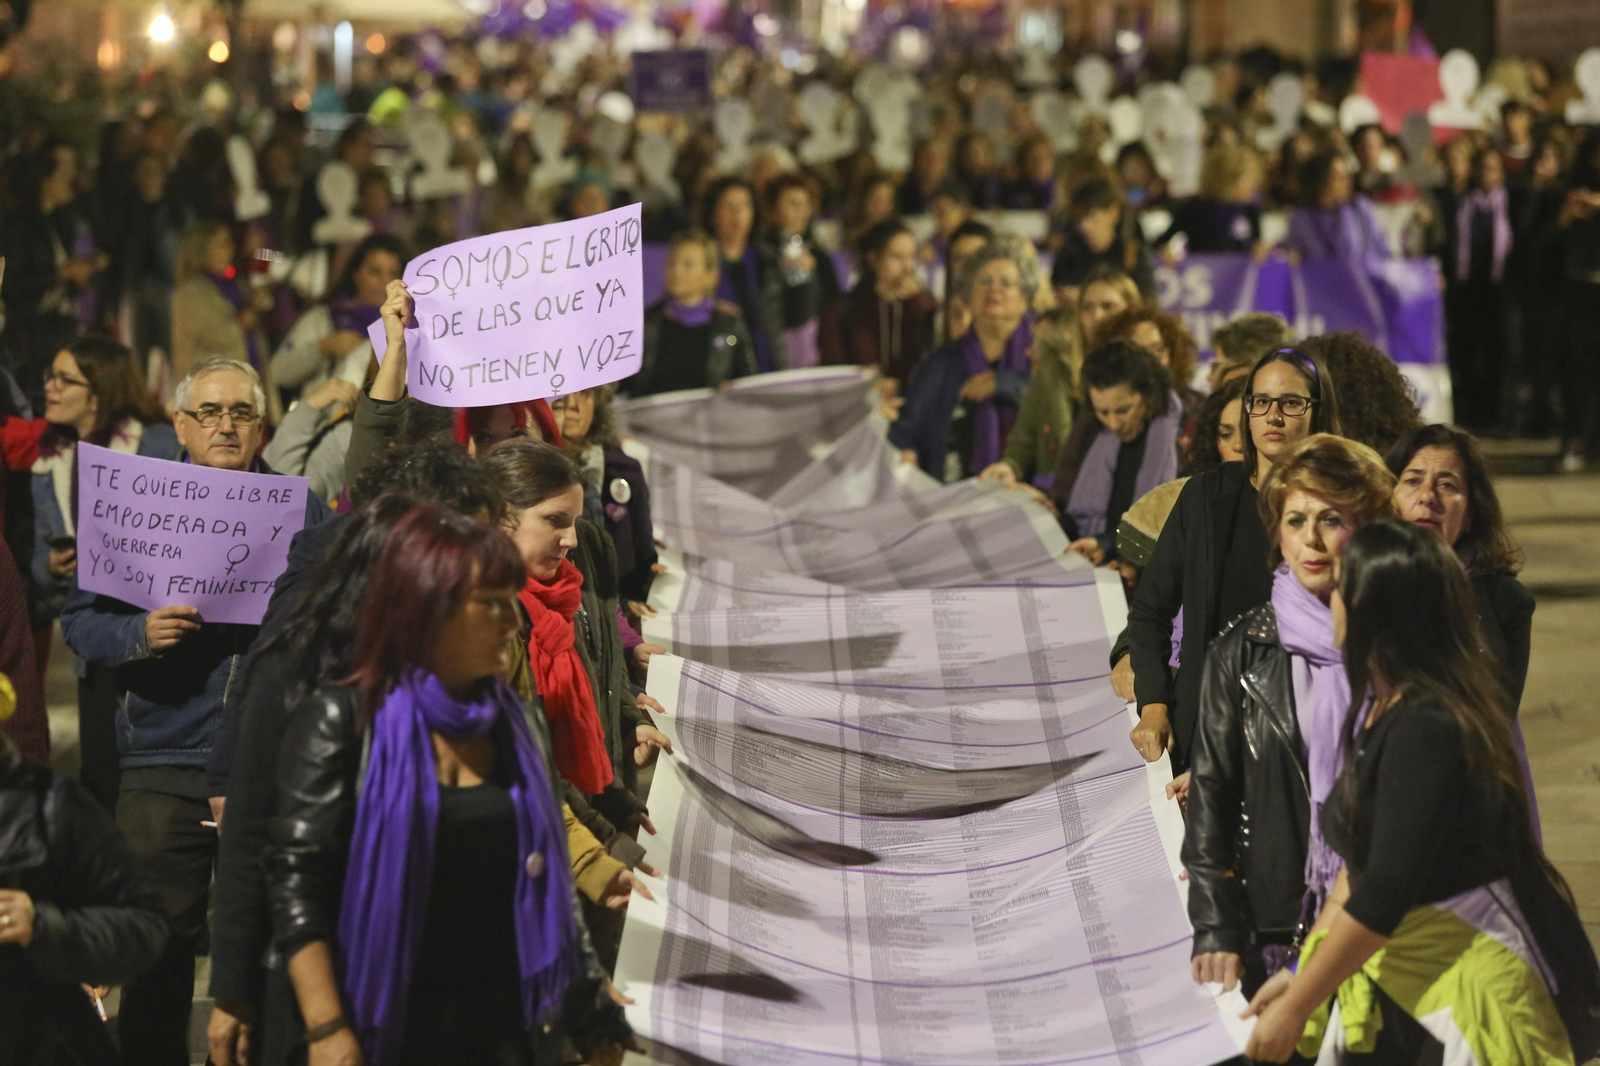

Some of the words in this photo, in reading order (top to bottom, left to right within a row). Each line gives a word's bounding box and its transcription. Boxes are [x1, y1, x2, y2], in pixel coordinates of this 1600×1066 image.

[412, 241, 533, 300] SOMOS
[541, 235, 581, 274] EL
[584, 217, 640, 267] GRITO
[432, 311, 464, 341] DE
[477, 301, 522, 332] LAS
[534, 290, 585, 321] QUE
[596, 278, 627, 314] YA
[419, 361, 455, 393] NO
[577, 330, 636, 372] VOZ
[90, 464, 121, 490] TE
[93, 499, 247, 538] EMPODERADA
[270, 525, 283, 542] Y
[102, 532, 182, 560] GUERRERA
[89, 549, 116, 577] YO
[123, 566, 155, 595] SOY
